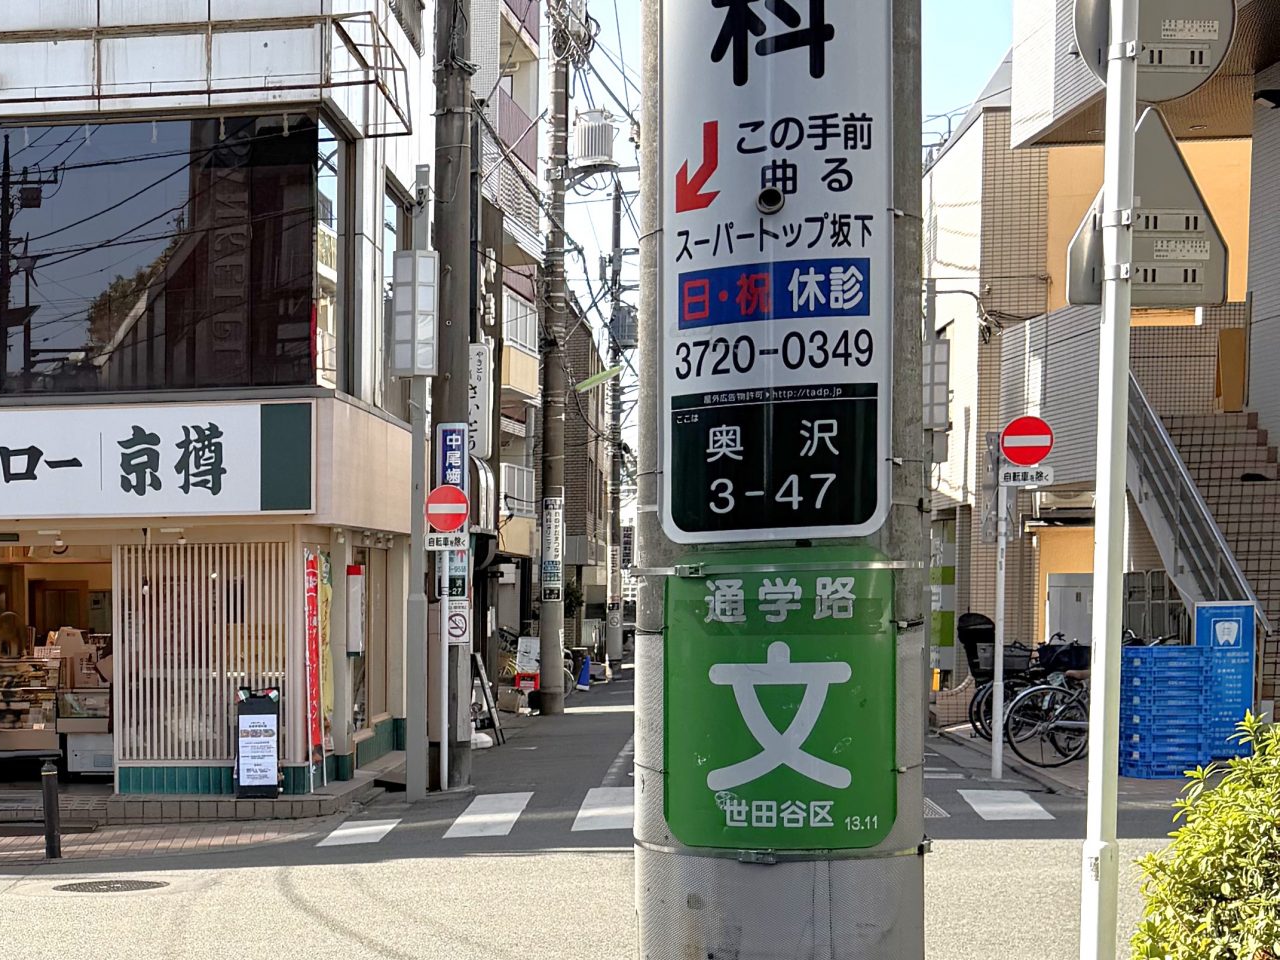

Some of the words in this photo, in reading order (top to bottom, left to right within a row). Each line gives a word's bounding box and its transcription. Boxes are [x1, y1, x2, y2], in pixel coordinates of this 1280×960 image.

[736, 112, 874, 155] この手前
[675, 211, 874, 263] スーパートップ坂下
[675, 328, 874, 380] 3720-0349
[675, 412, 700, 425] ここは
[116, 421, 227, 496] 京樽
[446, 432, 462, 485] 中尾歯
[708, 473, 837, 514] 3-47
[427, 536, 467, 548] 自転車を除く
[704, 576, 856, 624] 通学路
[723, 799, 835, 829] 世田谷区
[844, 815, 879, 831] 13.11
